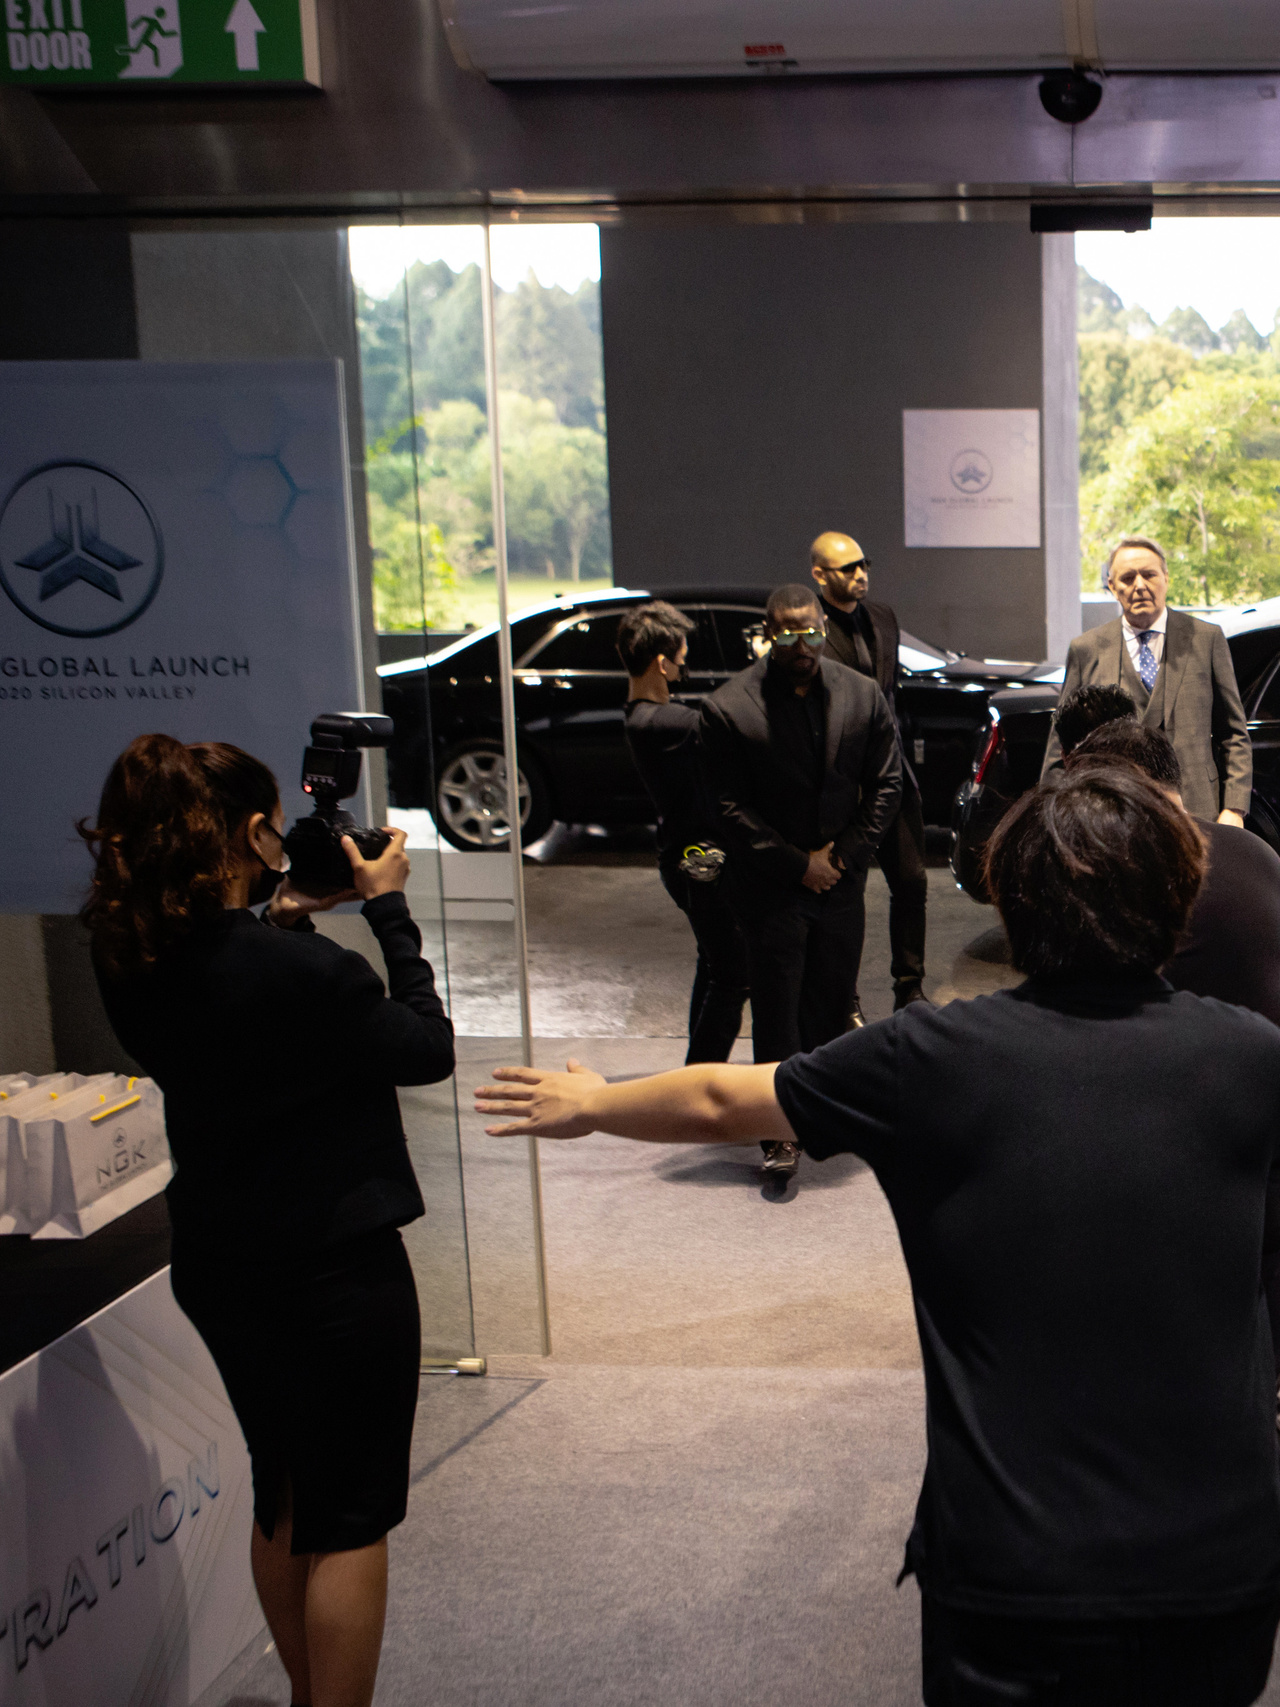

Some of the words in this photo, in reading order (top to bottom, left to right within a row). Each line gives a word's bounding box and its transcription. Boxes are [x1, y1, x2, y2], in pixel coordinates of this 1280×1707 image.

[7, 31, 93, 70] DOOR
[1, 656, 118, 677] GLOBAL
[130, 656, 250, 677] LAUNCH
[40, 686, 116, 699] SILICON
[125, 686, 196, 699] VALLEY
[96, 1138, 147, 1184] NGK
[0, 1440, 220, 1673] RATION
